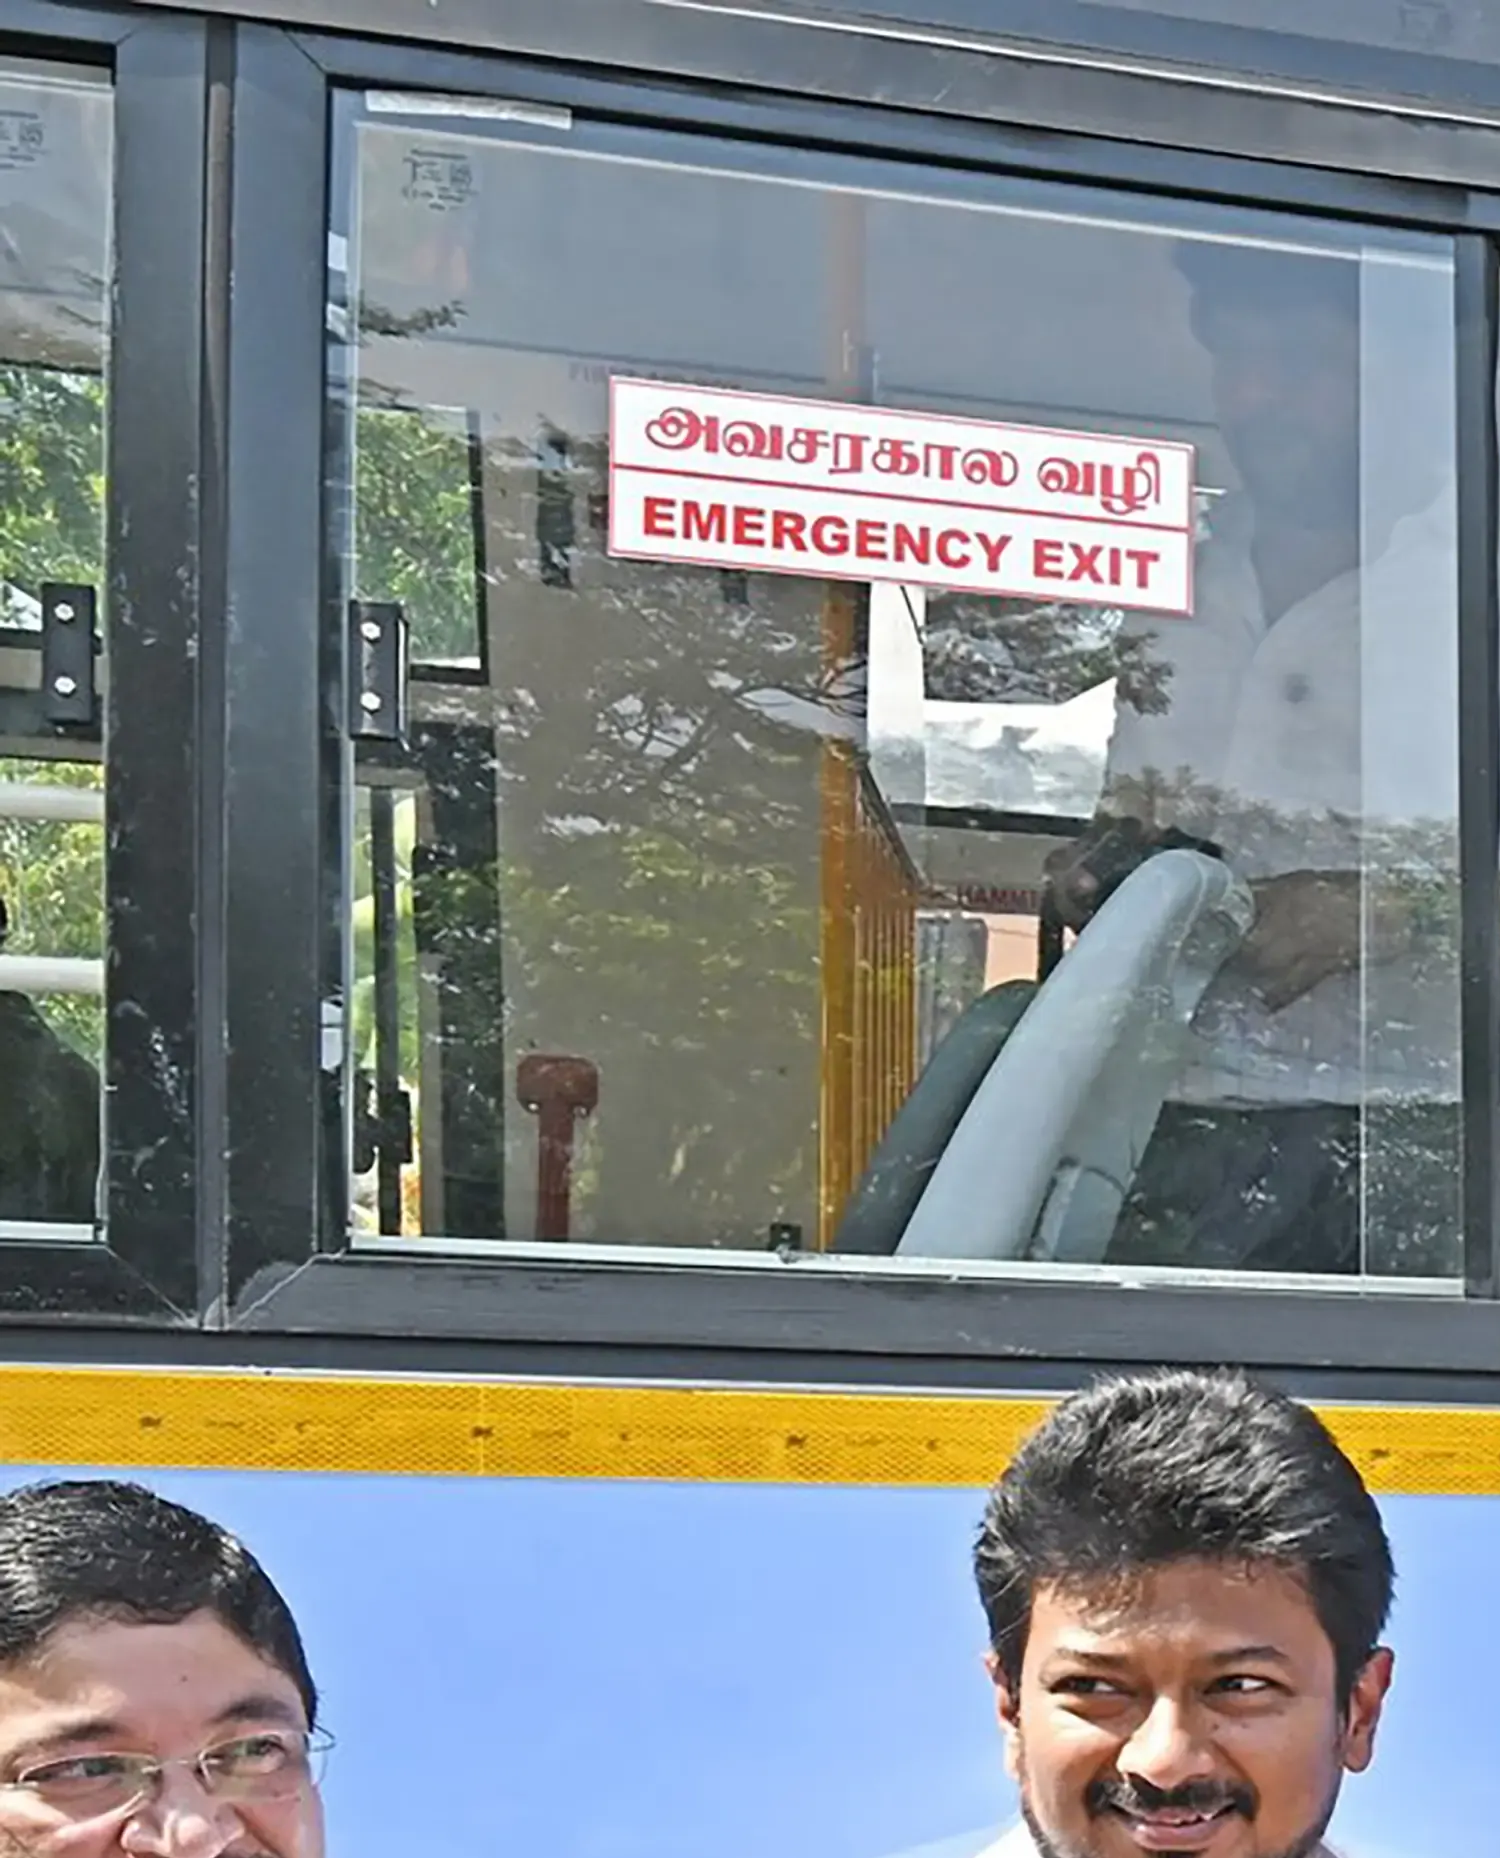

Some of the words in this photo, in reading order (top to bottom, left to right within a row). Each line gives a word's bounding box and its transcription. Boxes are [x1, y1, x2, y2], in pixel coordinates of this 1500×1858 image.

[645, 407, 1019, 487] அவசரகால
[1038, 451, 1161, 516] வழி
[643, 497, 1012, 573] EMERGENCY
[1032, 539, 1160, 589] EXIT
